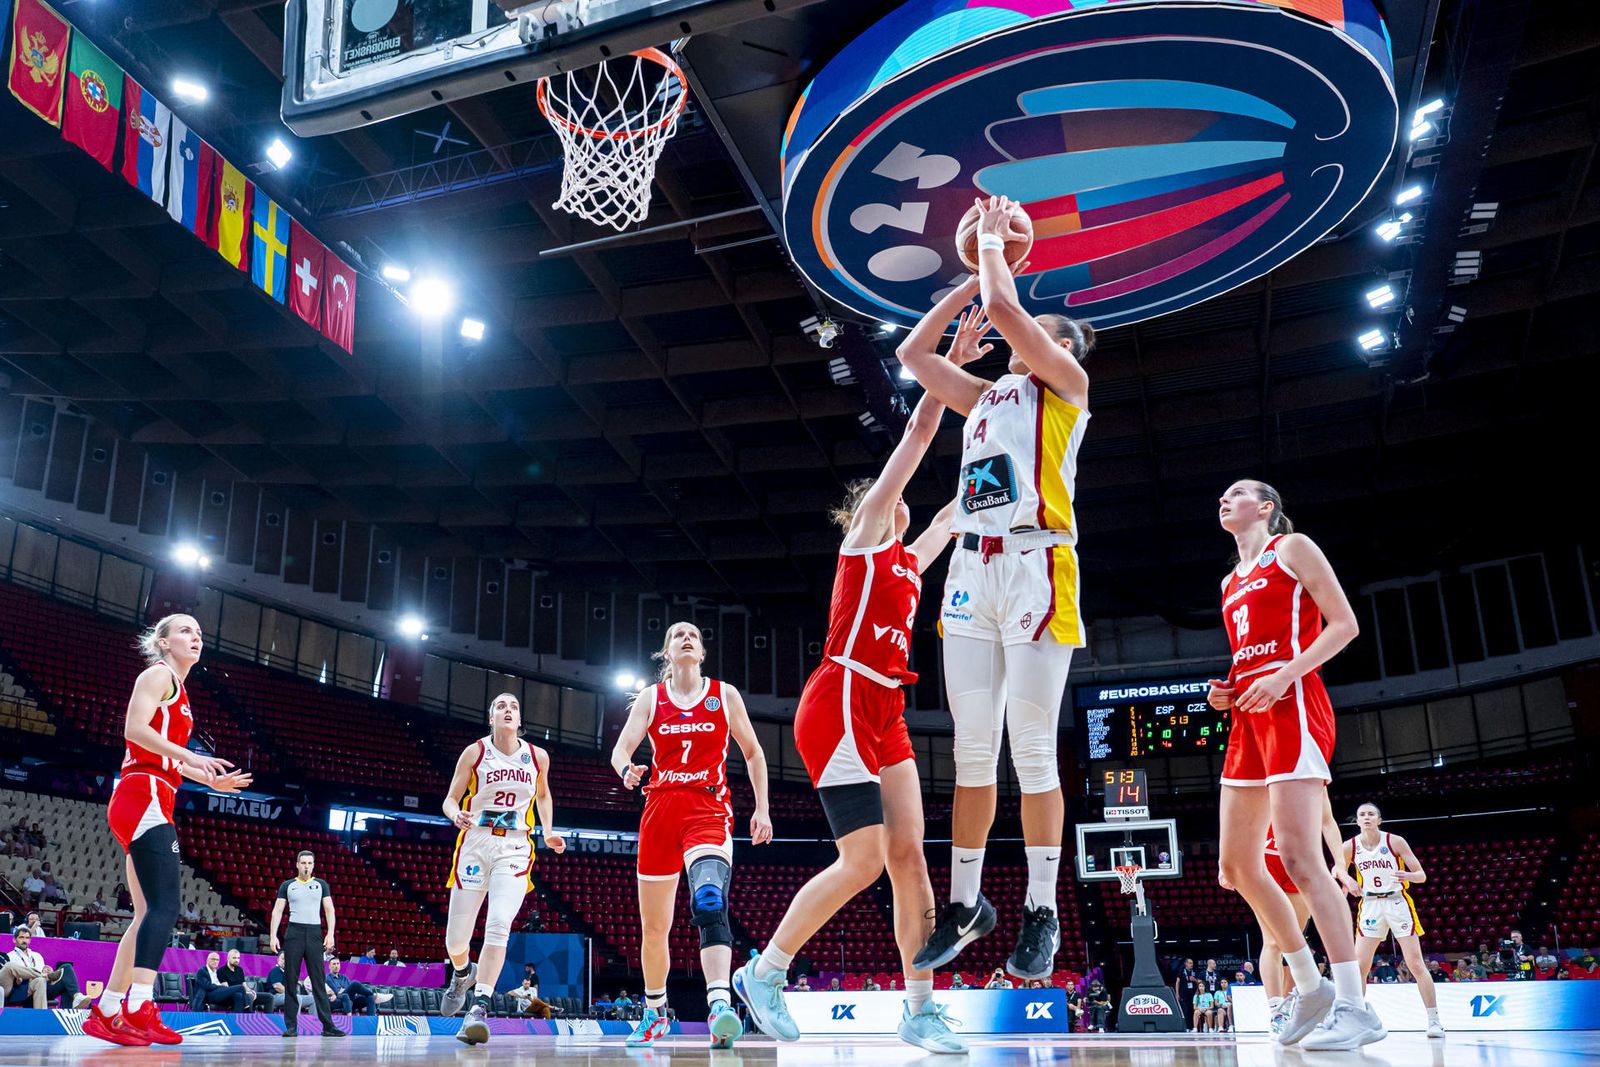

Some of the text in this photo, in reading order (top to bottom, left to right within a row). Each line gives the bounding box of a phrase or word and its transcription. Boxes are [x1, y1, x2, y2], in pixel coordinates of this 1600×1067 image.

[1155, 705, 1175, 715] ESP
[1187, 703, 1207, 712] CZE
[658, 722, 716, 735] ČESKO
[681, 740, 692, 764] 7
[486, 768, 532, 785] ESPAÑA
[494, 791, 517, 807] 20
[1120, 786, 1139, 803] 14
[208, 796, 282, 820] PIRAEUS
[579, 839, 600, 852] TO
[603, 841, 639, 855] DREA
[1359, 859, 1394, 871] ESPAÑA
[1373, 876, 1382, 887] 6
[831, 1003, 857, 1020] 1X
[1025, 1001, 1054, 1020] 1X
